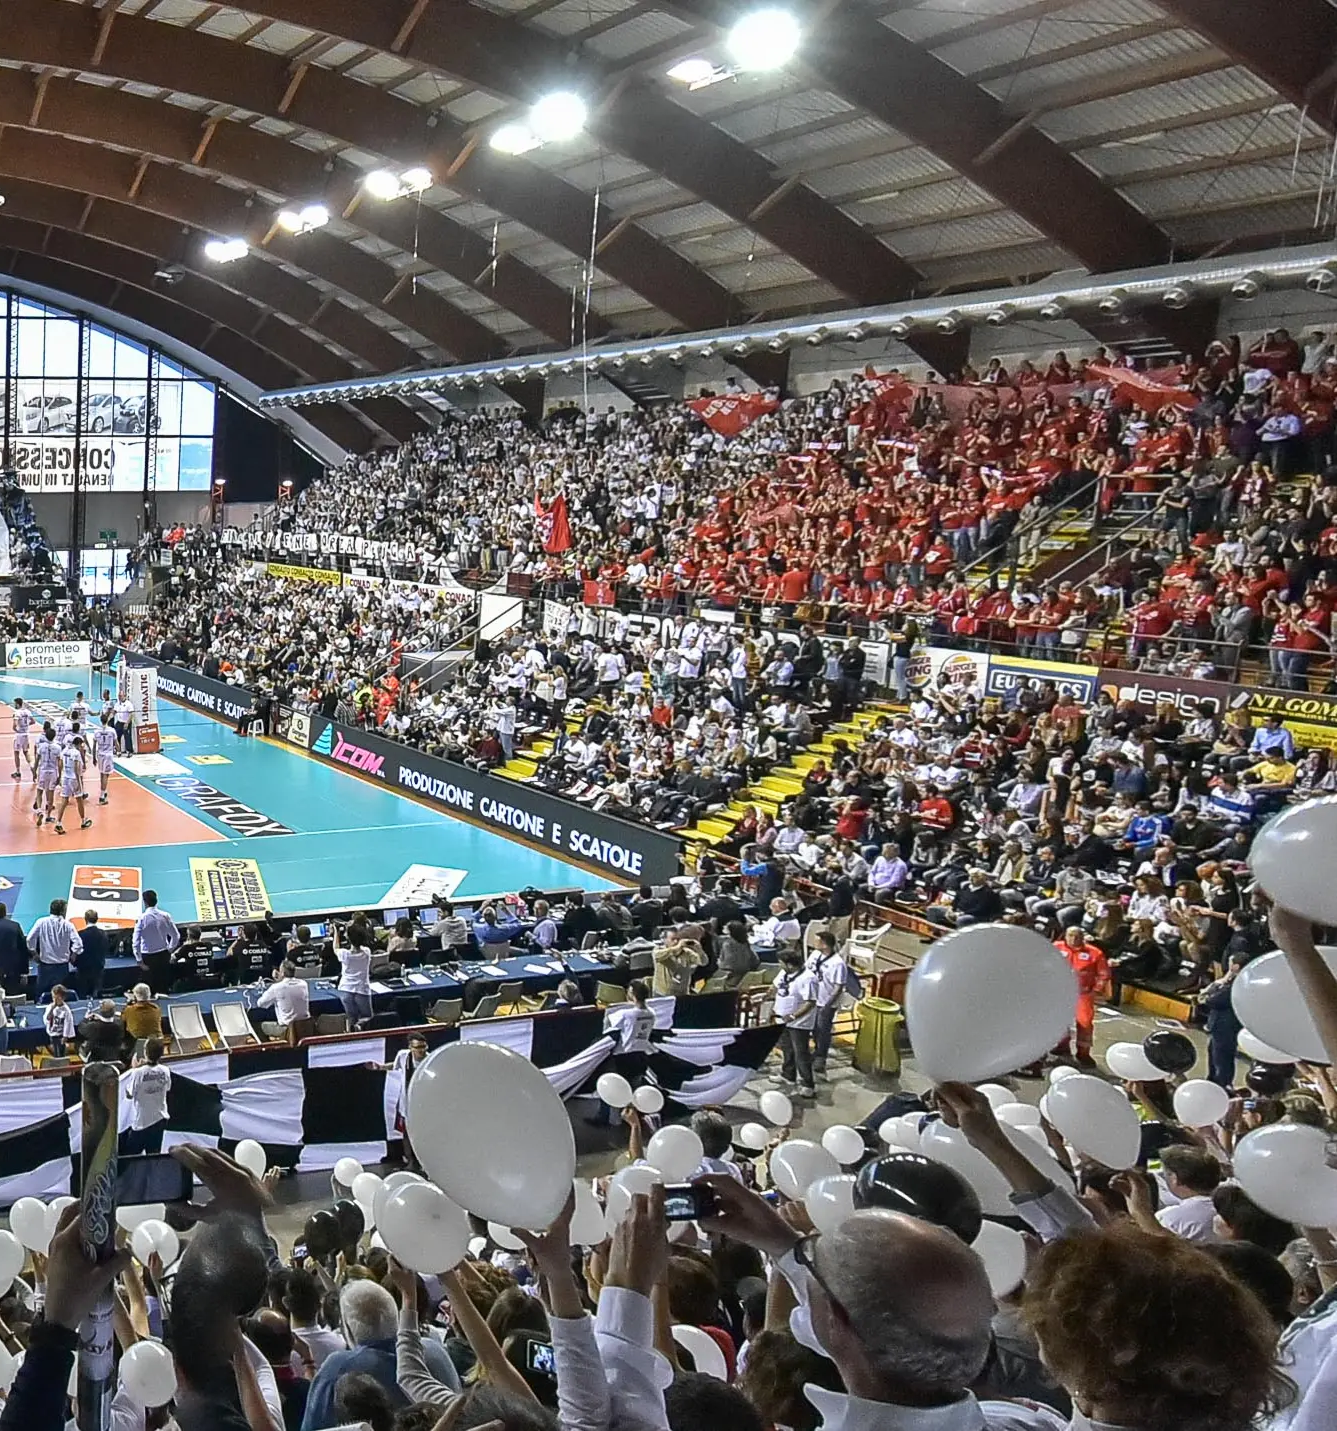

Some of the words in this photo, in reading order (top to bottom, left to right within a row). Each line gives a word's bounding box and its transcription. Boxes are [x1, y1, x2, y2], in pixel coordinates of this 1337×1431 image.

[25, 644, 80, 655] prometeo
[25, 656, 56, 666] estra
[945, 662, 977, 673] BURGER
[186, 684, 215, 709] CARTONE
[216, 700, 223, 712] E
[1119, 683, 1221, 717] design
[1248, 693, 1284, 708] NT
[155, 777, 294, 837] GRAFOX
[399, 766, 474, 811] PRODUZIONE
[480, 797, 545, 838] CARTONE
[552, 824, 561, 845] E
[569, 830, 643, 876] SCATOLE
[241, 871, 266, 912] UMBRIA
